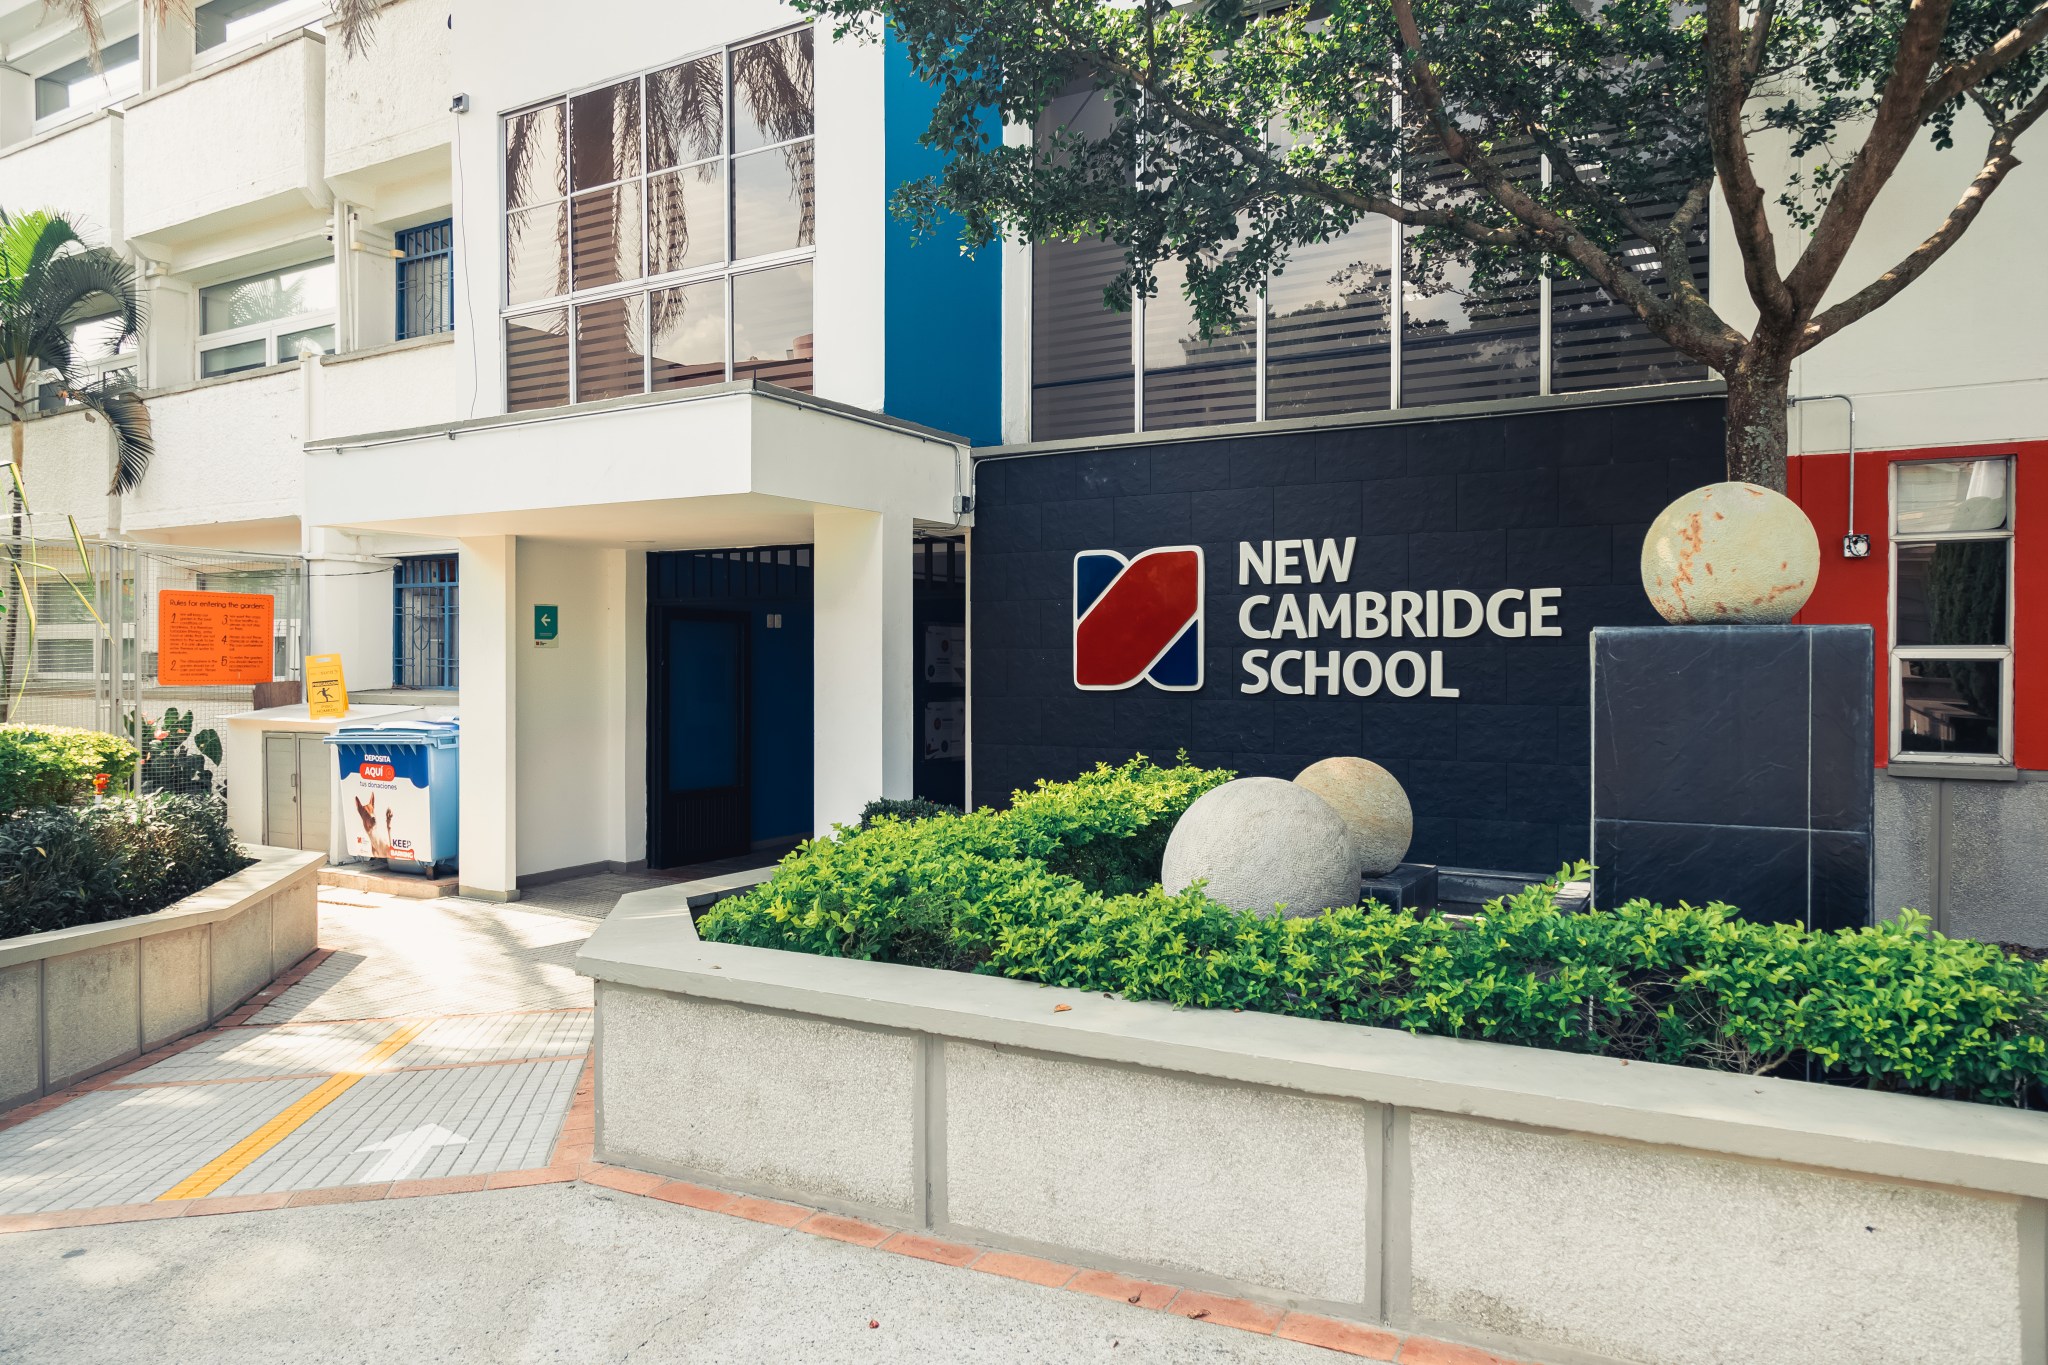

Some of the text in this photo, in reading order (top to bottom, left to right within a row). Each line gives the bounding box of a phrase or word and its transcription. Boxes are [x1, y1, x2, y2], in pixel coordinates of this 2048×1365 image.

[1238, 536, 1357, 586] NEW
[169, 599, 187, 607] Rules
[199, 601, 227, 609] entering
[1238, 587, 1563, 640] CAMBRIDGE
[1239, 648, 1461, 699] SCHOOL
[364, 754, 391, 762] DEPOSITA
[364, 766, 383, 777] AQUÍ
[368, 782, 397, 790] donaciones
[392, 839, 412, 849] KEEP
